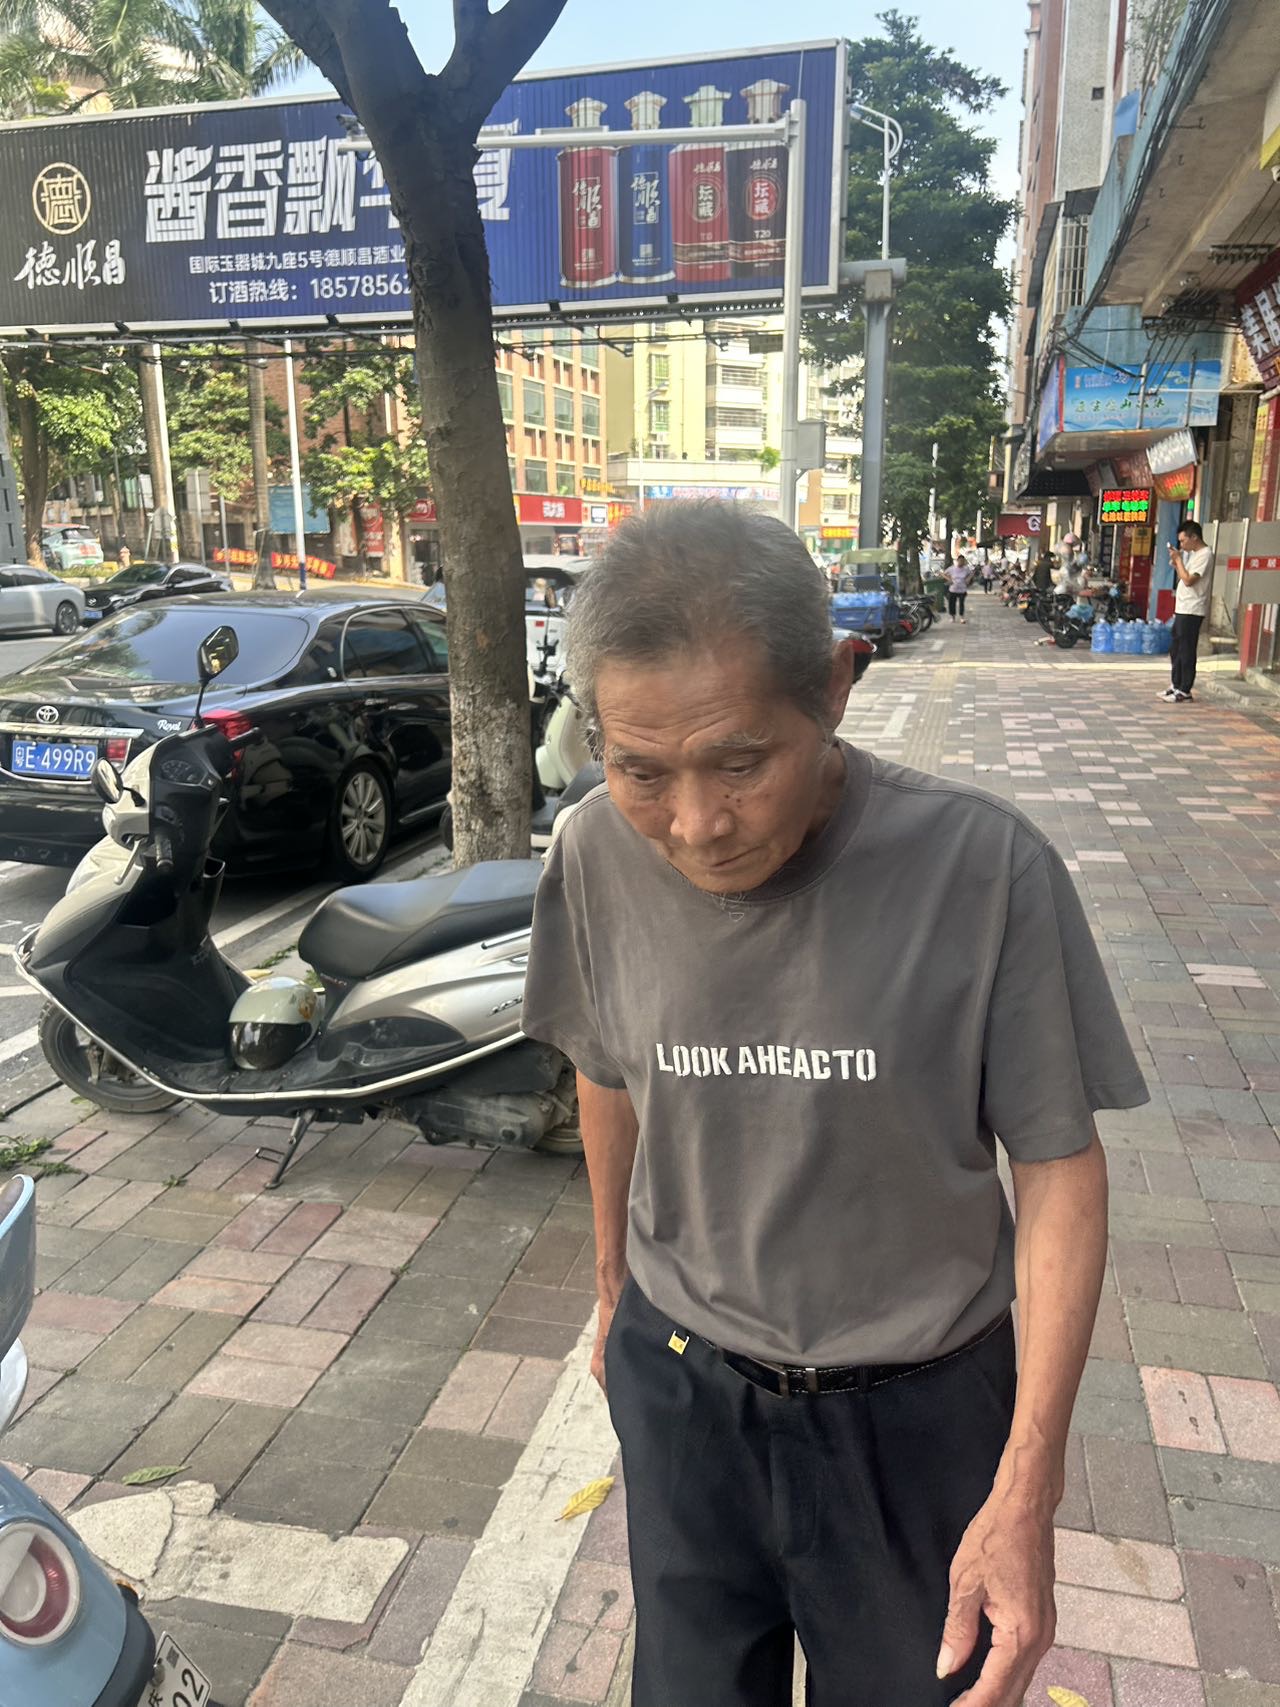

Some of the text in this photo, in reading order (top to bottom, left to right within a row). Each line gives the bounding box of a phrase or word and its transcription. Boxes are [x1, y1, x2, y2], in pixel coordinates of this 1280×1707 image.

[14, 239, 126, 290] 德顺昌
[157, 719, 182, 733] Royal
[656, 1043, 732, 1078] LOOK
